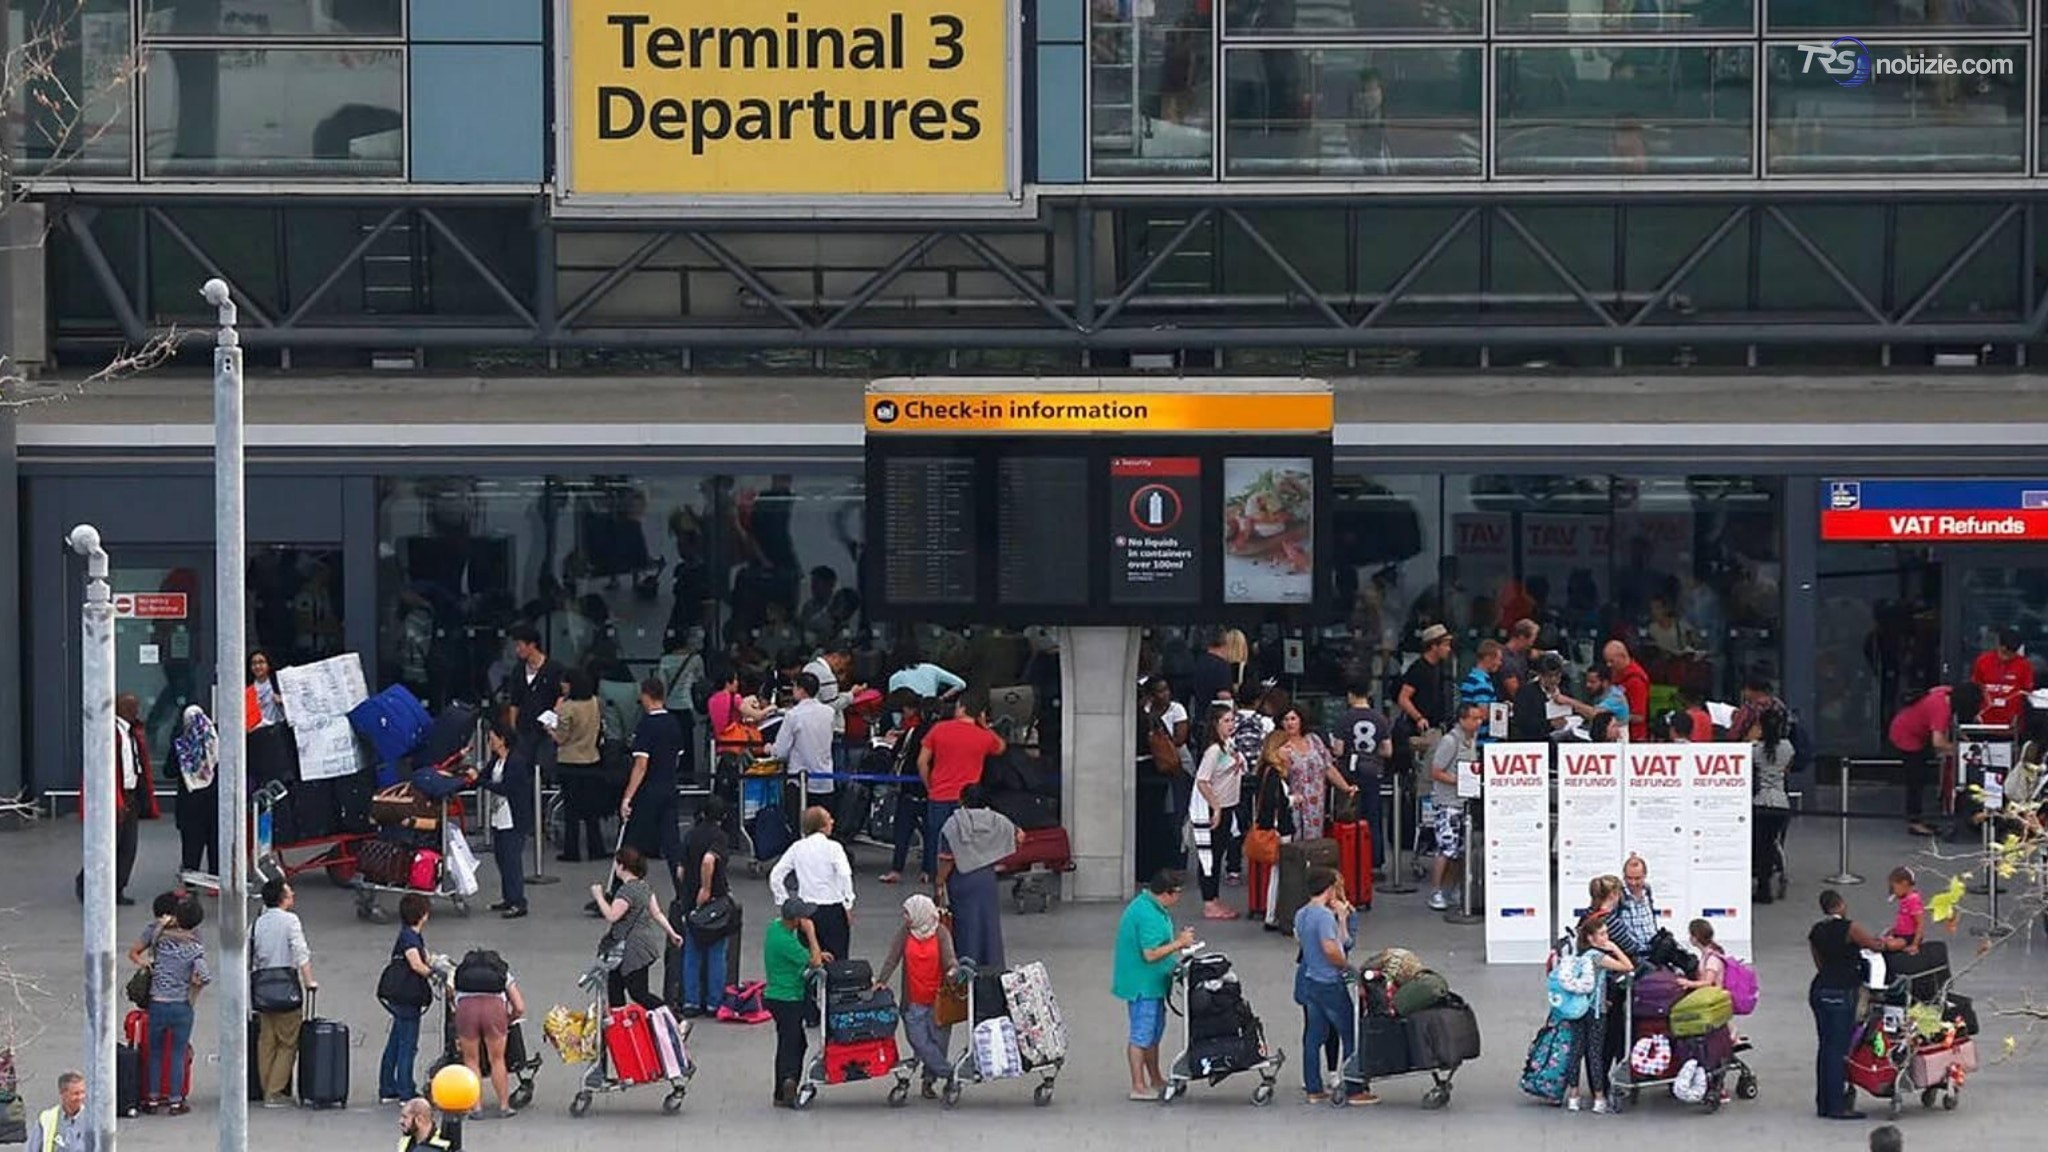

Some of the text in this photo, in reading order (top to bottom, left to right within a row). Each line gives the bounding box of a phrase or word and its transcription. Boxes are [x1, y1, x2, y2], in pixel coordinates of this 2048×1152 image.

[607, 13, 965, 70] Terminal 3
[597, 86, 981, 155] Departures
[904, 400, 1148, 419] Check-in information
[1889, 515, 2026, 535] VAT Refunds
[1128, 537, 1178, 549] No liquids
[1128, 548, 1192, 558] in containers
[1128, 560, 1184, 569] over 100ml
[1353, 720, 1377, 753] 8
[1491, 754, 1542, 775] VAT
[1566, 754, 1617, 775] VAT
[1631, 755, 1682, 776] VAT
[1695, 755, 1746, 775] VAT
[1490, 777, 1543, 788] REFUNDS
[1564, 777, 1617, 788] REFUNDS
[1629, 777, 1682, 788] REFUNDS
[1693, 777, 1746, 788] REFUNDS
